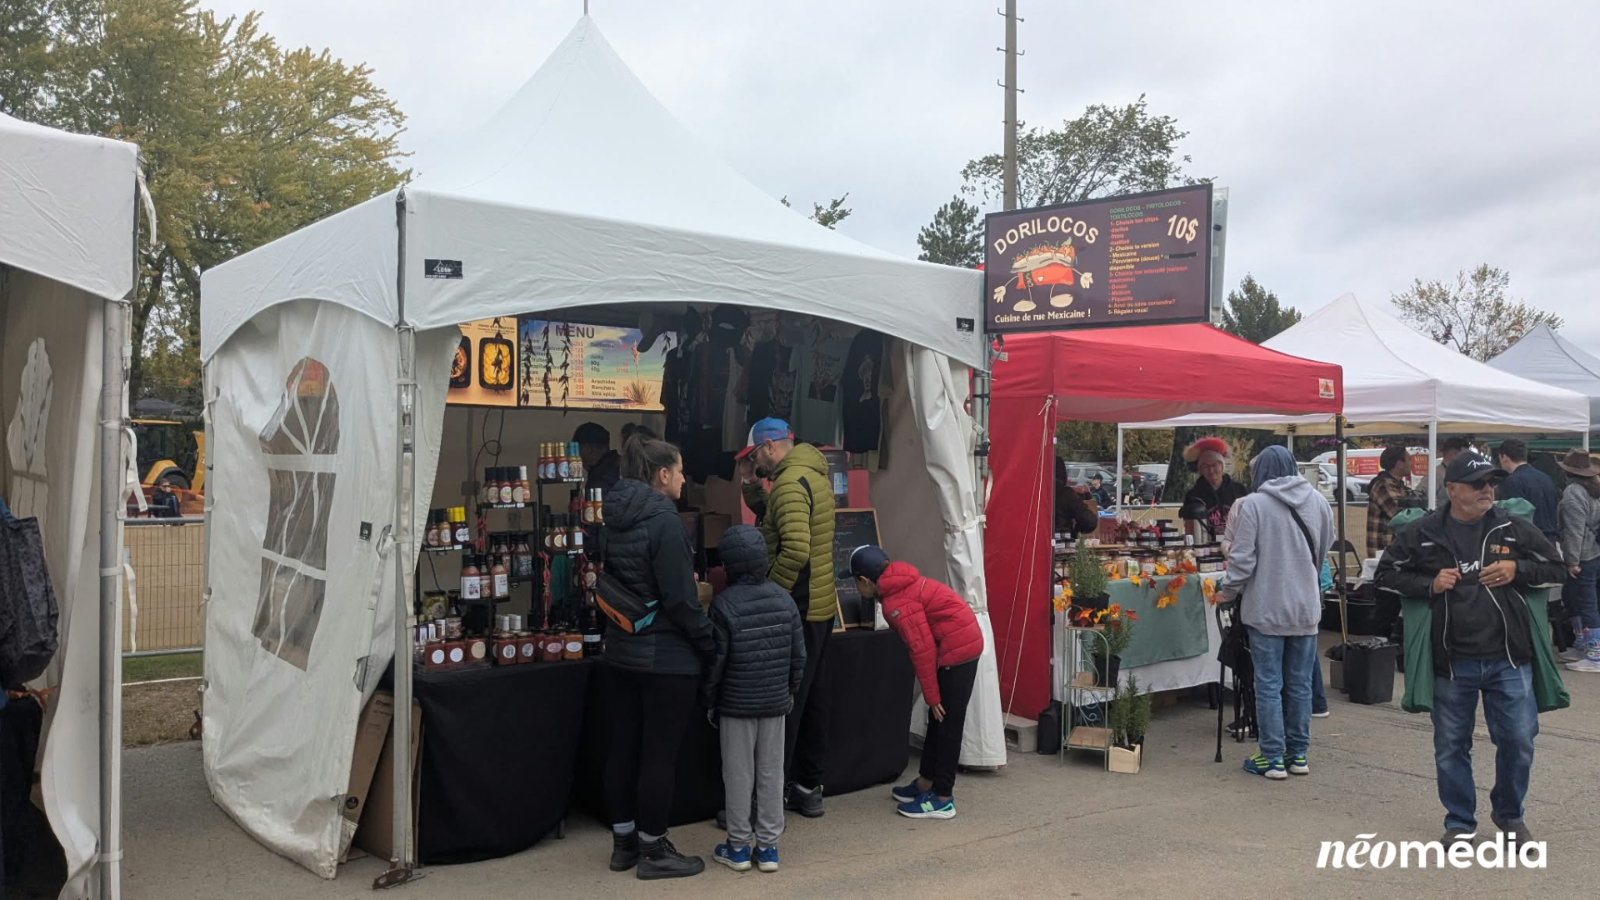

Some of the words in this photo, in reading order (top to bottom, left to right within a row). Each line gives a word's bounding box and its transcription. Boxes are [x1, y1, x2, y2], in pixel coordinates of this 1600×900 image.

[994, 216, 1099, 255] DORILOCOS
[1167, 214, 1199, 244] 10$
[994, 314, 1021, 323] Cuisine
[1022, 312, 1032, 321] de
[1033, 313, 1046, 321] rue
[1047, 309, 1085, 320] Mexicaine
[555, 324, 595, 339] MENU
